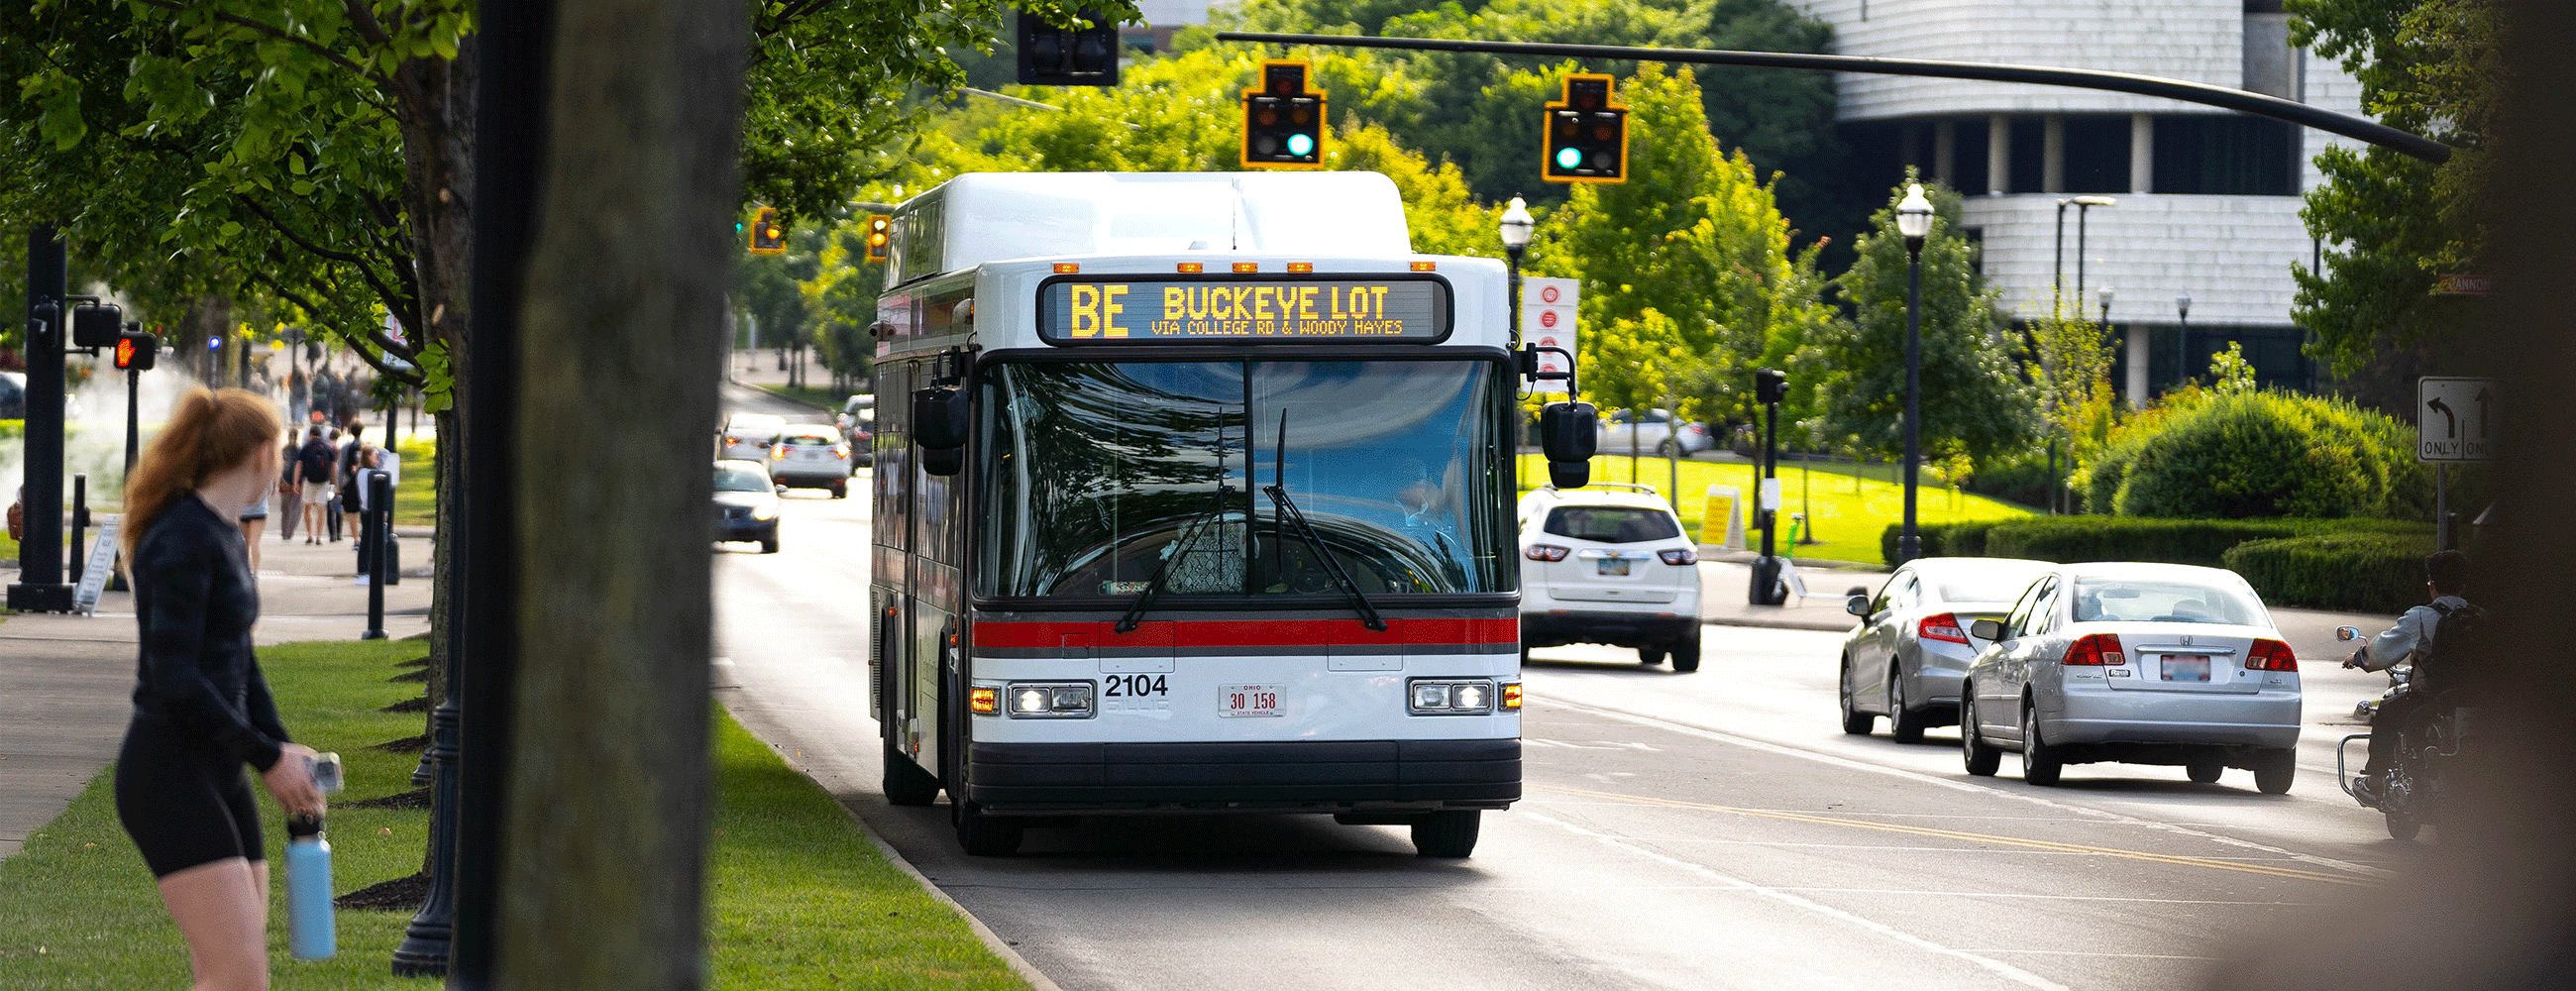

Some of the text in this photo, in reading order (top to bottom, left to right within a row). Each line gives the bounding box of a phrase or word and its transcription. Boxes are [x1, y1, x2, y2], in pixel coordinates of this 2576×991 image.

[1071, 284, 1128, 338] BE
[1164, 286, 1388, 320] BUCKEYE LOT
[1151, 320, 1403, 335] VIA COLLEGE RD & WOODY HAYES
[2424, 442, 2458, 455] ONLY
[1105, 674, 1168, 697] 2104
[1231, 693, 1275, 710] 30 158
